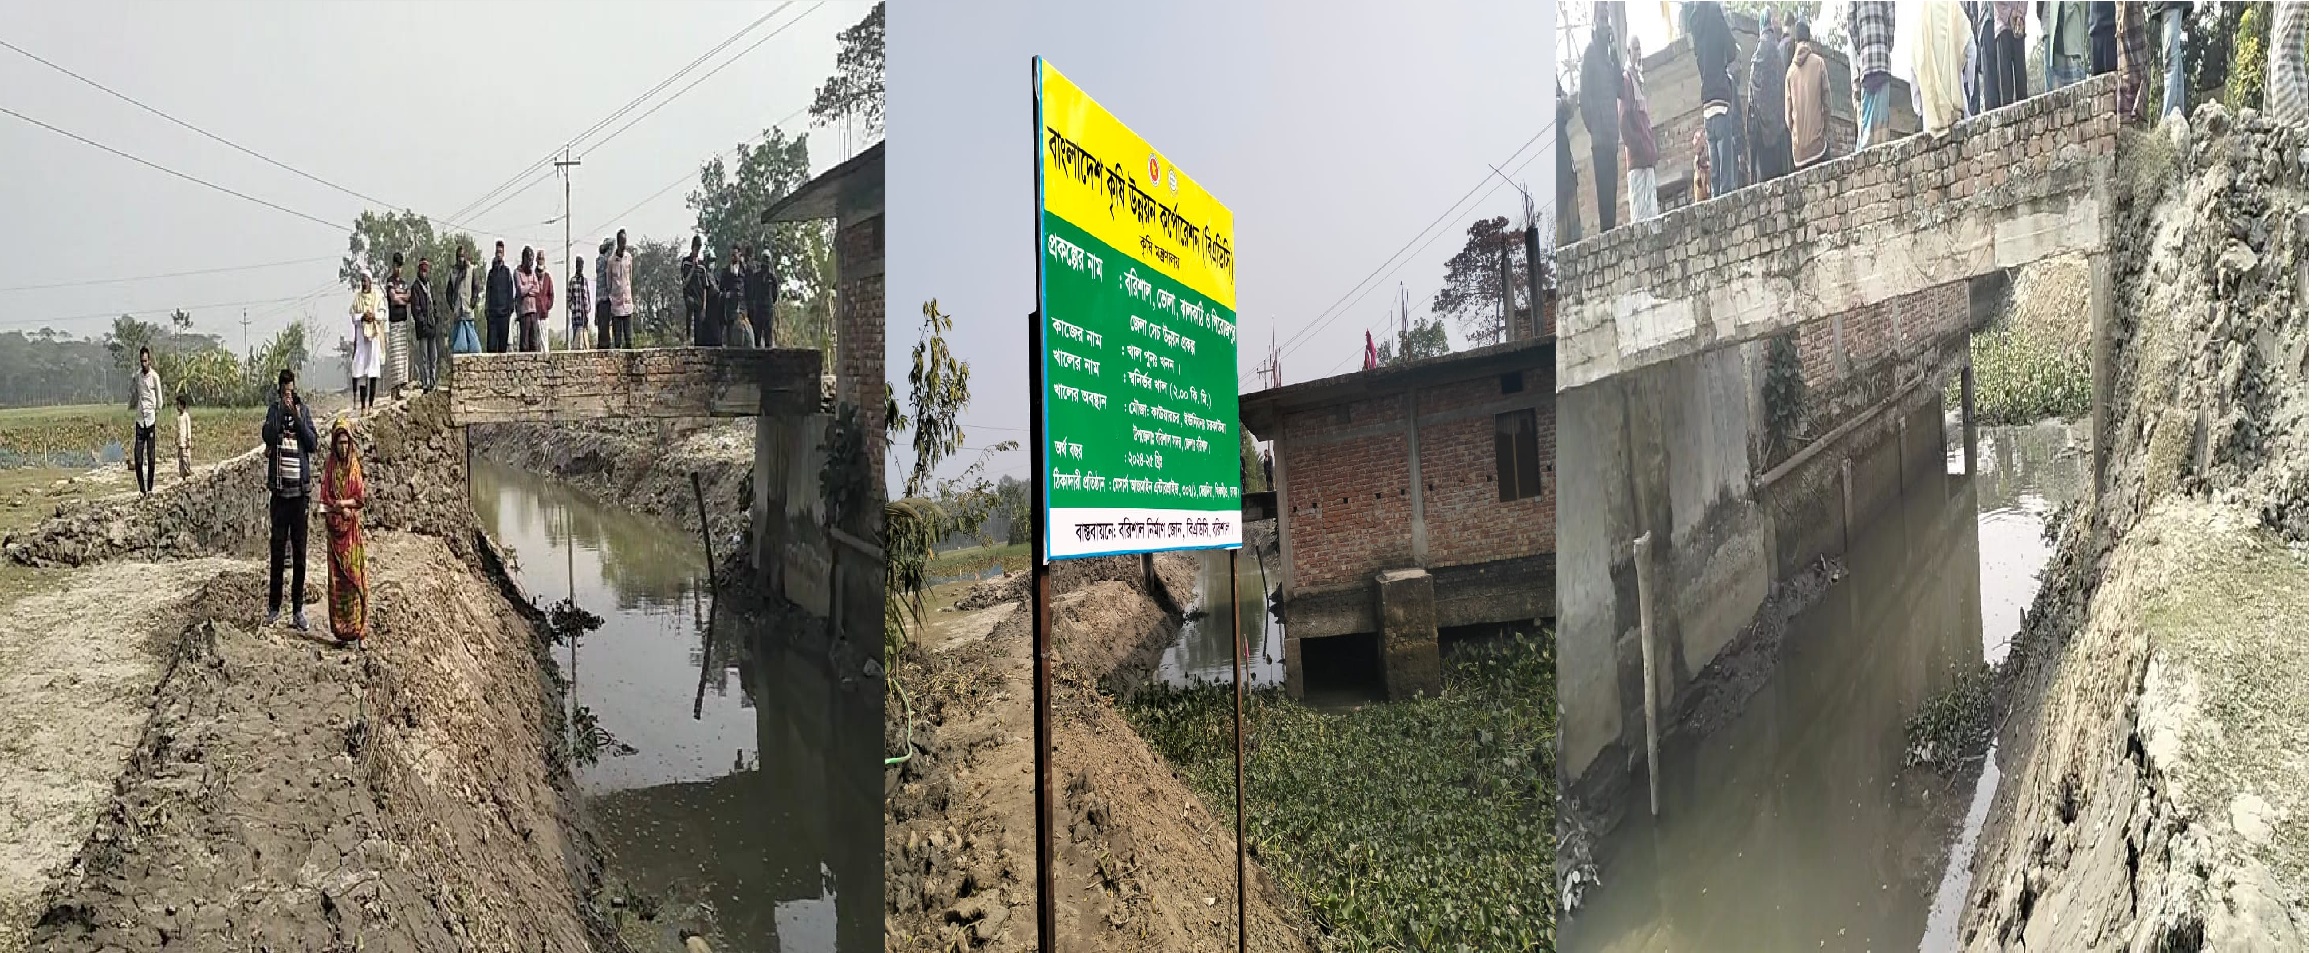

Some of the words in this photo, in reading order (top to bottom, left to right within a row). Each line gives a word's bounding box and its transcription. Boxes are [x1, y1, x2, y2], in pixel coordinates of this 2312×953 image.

[1047, 125, 1103, 195] বাংলাদেশ
[1106, 163, 1125, 220] কৃষি
[1128, 171, 1156, 228] উন্নয়ন
[1158, 203, 1200, 256] কর্পোরেশন
[1202, 225, 1233, 285] (বিএডিসি)
[1139, 235, 1153, 258] কৃষি
[1155, 244, 1180, 269] মন্ত্রণালয়
[1048, 233, 1084, 272] প্রকল্পের
[1087, 252, 1103, 282] নাম
[1205, 313, 1210, 329] ও
[1051, 316, 1084, 342] কাজের
[1086, 330, 1102, 349] নাম
[1127, 345, 1142, 362] খাল
[1144, 351, 1157, 369] পুনঃ
[1160, 356, 1174, 373] খনন
[1130, 315, 1147, 336] জেলা
[1149, 321, 1161, 340] সেচ
[1162, 325, 1179, 348] উন্নয়ন
[1181, 336, 1195, 355] প্রকল্প
[1053, 349, 1082, 371] খালের
[1084, 359, 1100, 377] নাম
[1128, 368, 1152, 390] স্বনির্ভর
[1154, 379, 1167, 394] খাল
[1054, 382, 1078, 402] খালের
[1082, 388, 1107, 411] অবস্থান
[1054, 436, 1067, 458] অর্থ
[1069, 443, 1083, 460] বছর
[1127, 451, 1153, 468] ২০২৪-২৫
[1053, 467, 1081, 491] ঠিকাদারী
[1082, 471, 1106, 493] প্রতিষ্ঠান
[1075, 522, 1116, 543] বাস্তবায়নে:
[1118, 517, 1144, 540] বরিশাল
[1146, 517, 1165, 539] নির্মাণ
